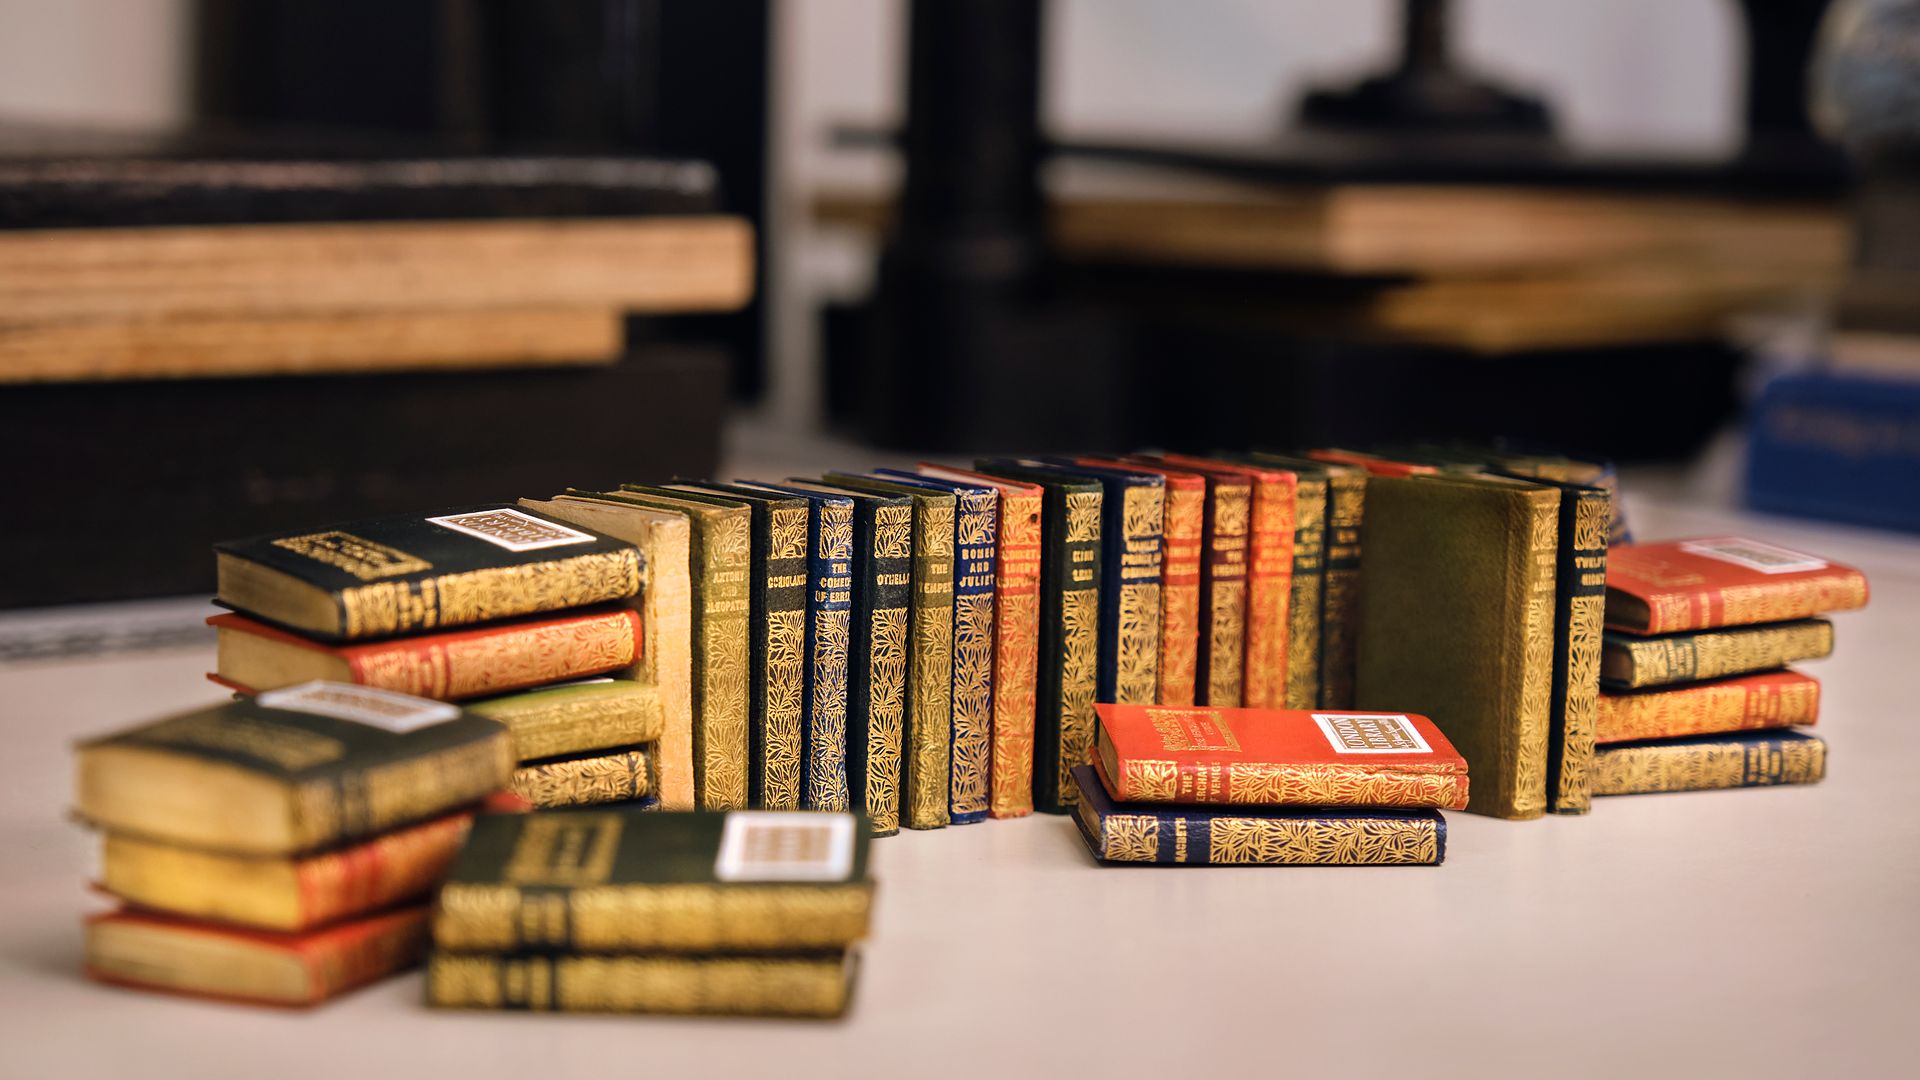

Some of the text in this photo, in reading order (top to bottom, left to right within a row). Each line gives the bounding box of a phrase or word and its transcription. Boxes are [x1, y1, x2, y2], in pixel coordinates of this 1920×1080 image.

[962, 547, 994, 560] ROMEO
[832, 563, 847, 573] THE
[969, 561, 989, 573] AND
[1575, 556, 1606, 568] TWELFT
[931, 564, 948, 574] THE
[820, 577, 851, 588] COMED
[959, 574, 994, 587] JULIET
[1333, 718, 1369, 750] LONDON
[1356, 719, 1393, 750] LIBRARY
[1182, 772, 1193, 795] THE
[1196, 761, 1208, 802] ERCHANT
